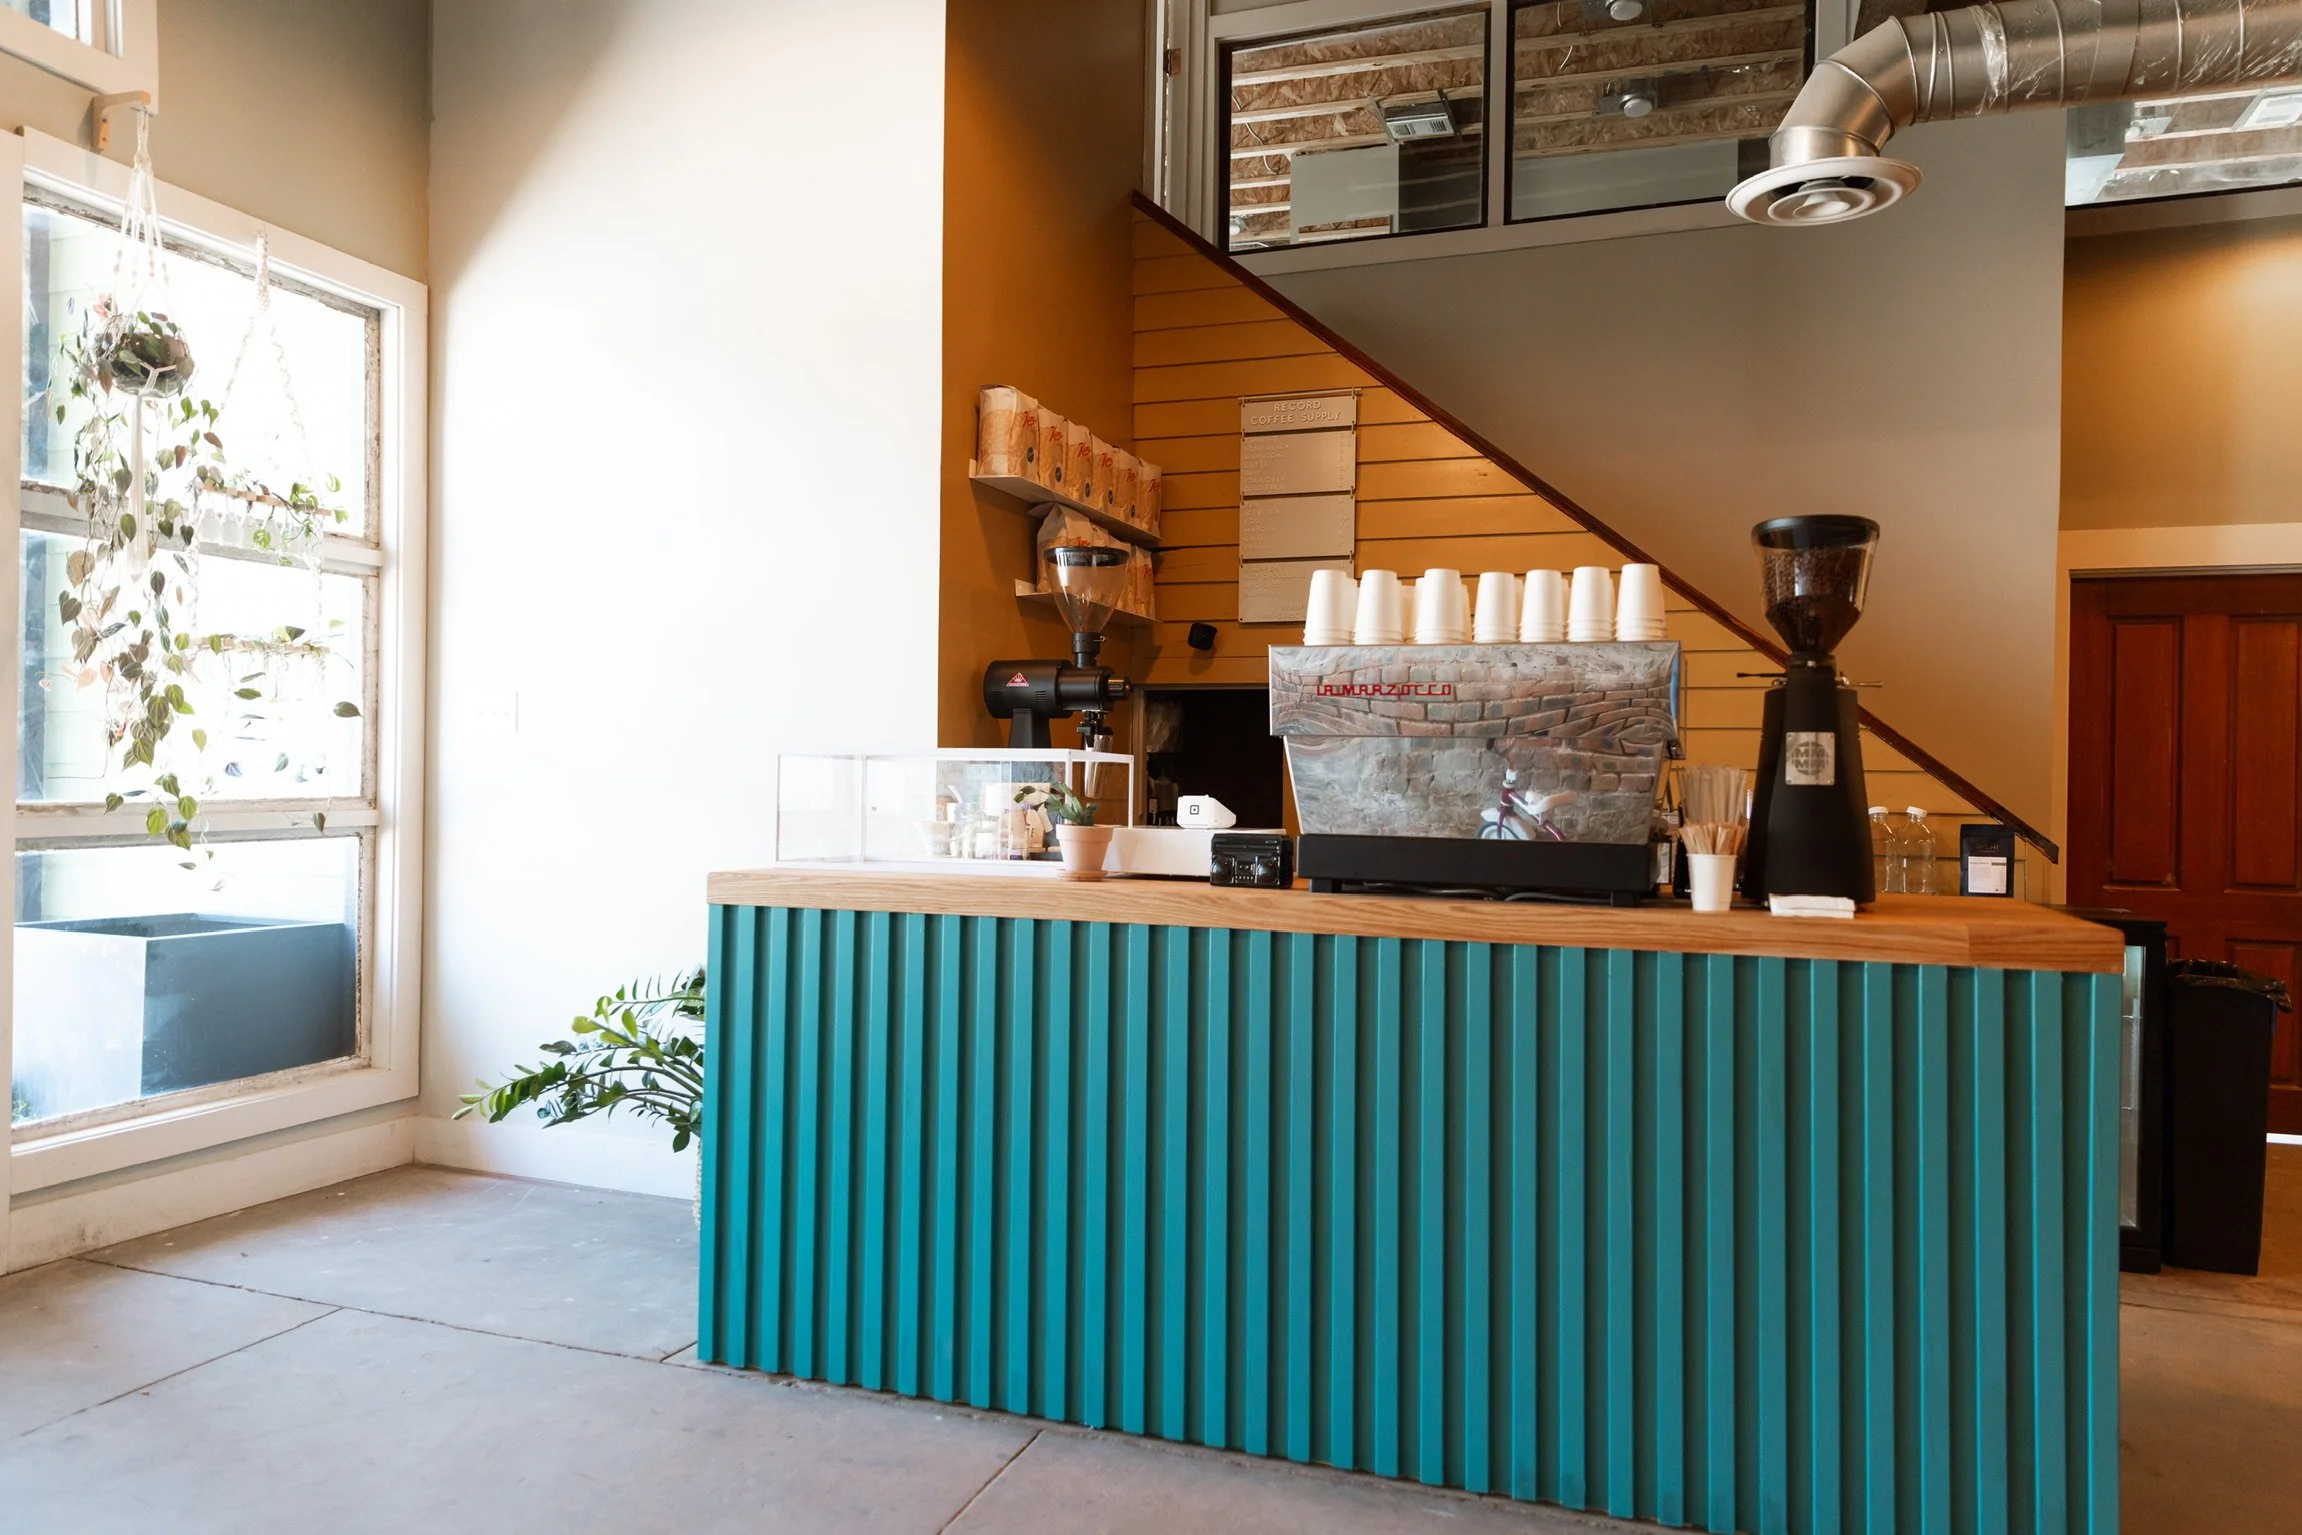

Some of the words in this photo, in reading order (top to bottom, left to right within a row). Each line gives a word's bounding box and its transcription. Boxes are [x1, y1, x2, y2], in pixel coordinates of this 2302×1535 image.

[1274, 401, 1321, 412] RECORD
[1250, 414, 1294, 426] COFFEE
[1301, 411, 1341, 422] SUPPLY
[1317, 684, 1333, 697] LA
